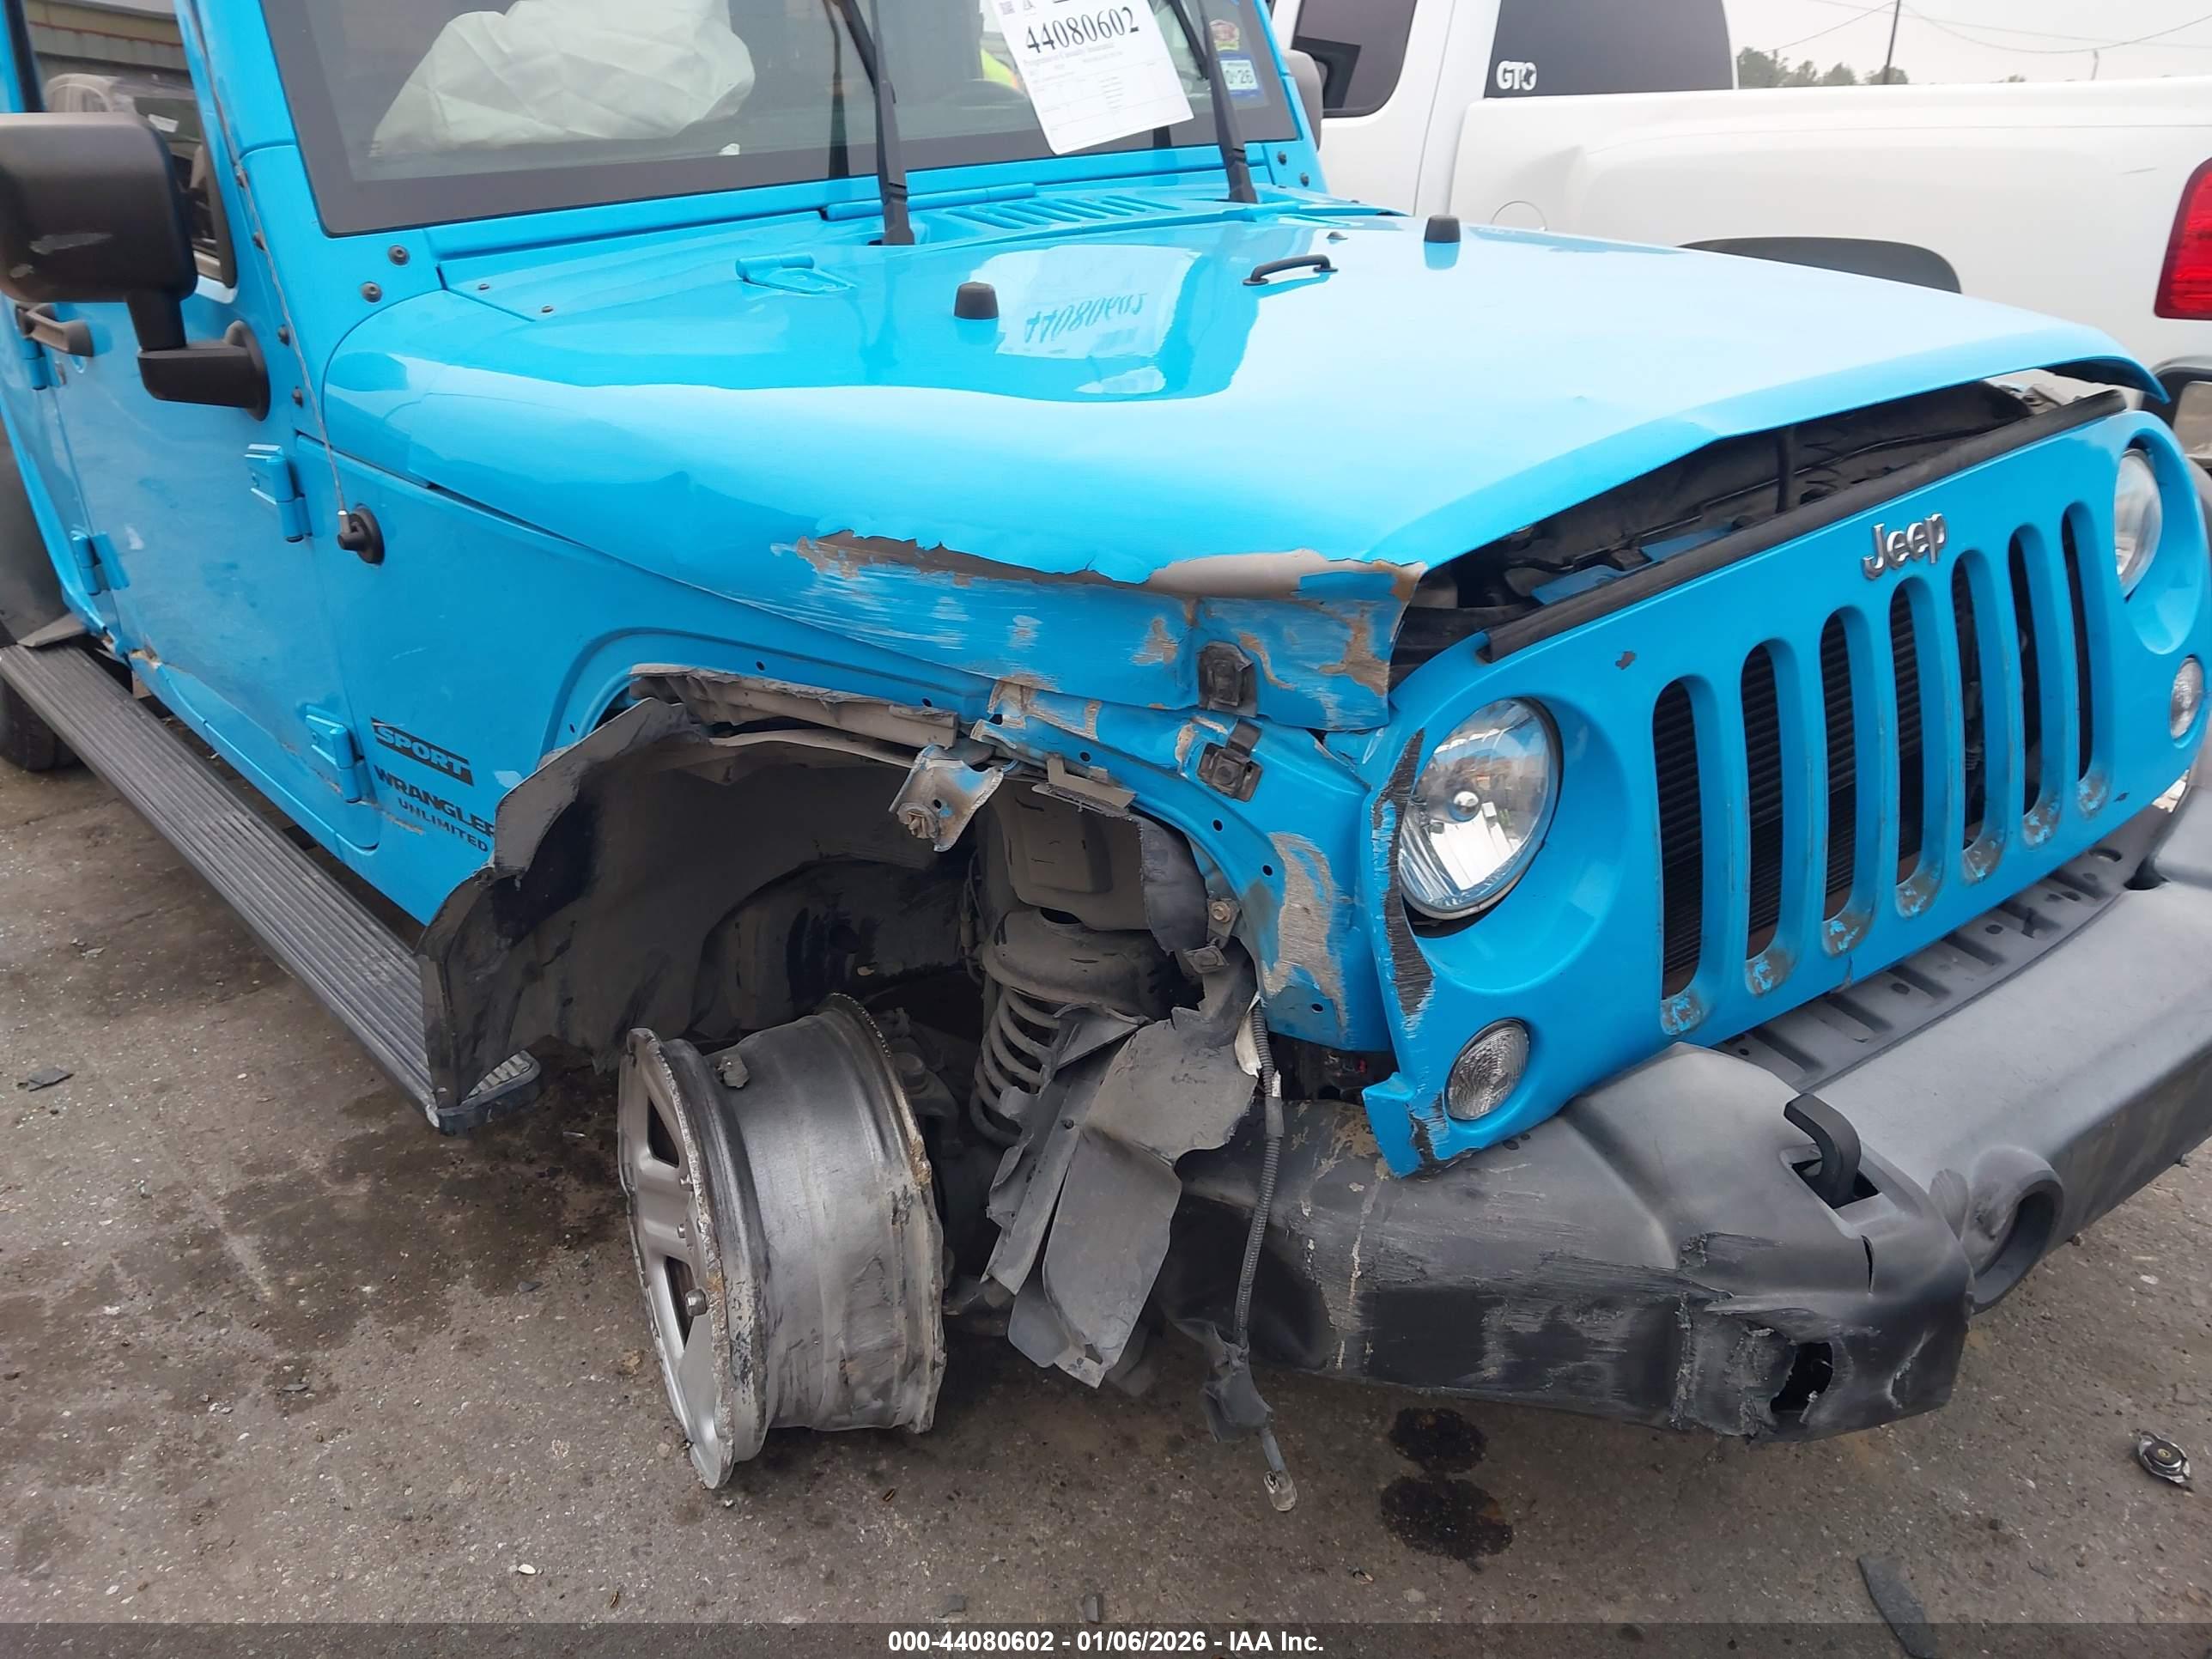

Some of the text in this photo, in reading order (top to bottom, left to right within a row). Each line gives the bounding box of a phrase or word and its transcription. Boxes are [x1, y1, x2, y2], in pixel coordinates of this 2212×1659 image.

[1026, 6, 1139, 53] 44080602
[1862, 513, 1947, 580] Jeep
[373, 726, 471, 775] SPORT
[398, 797, 489, 852] UNLIMITED
